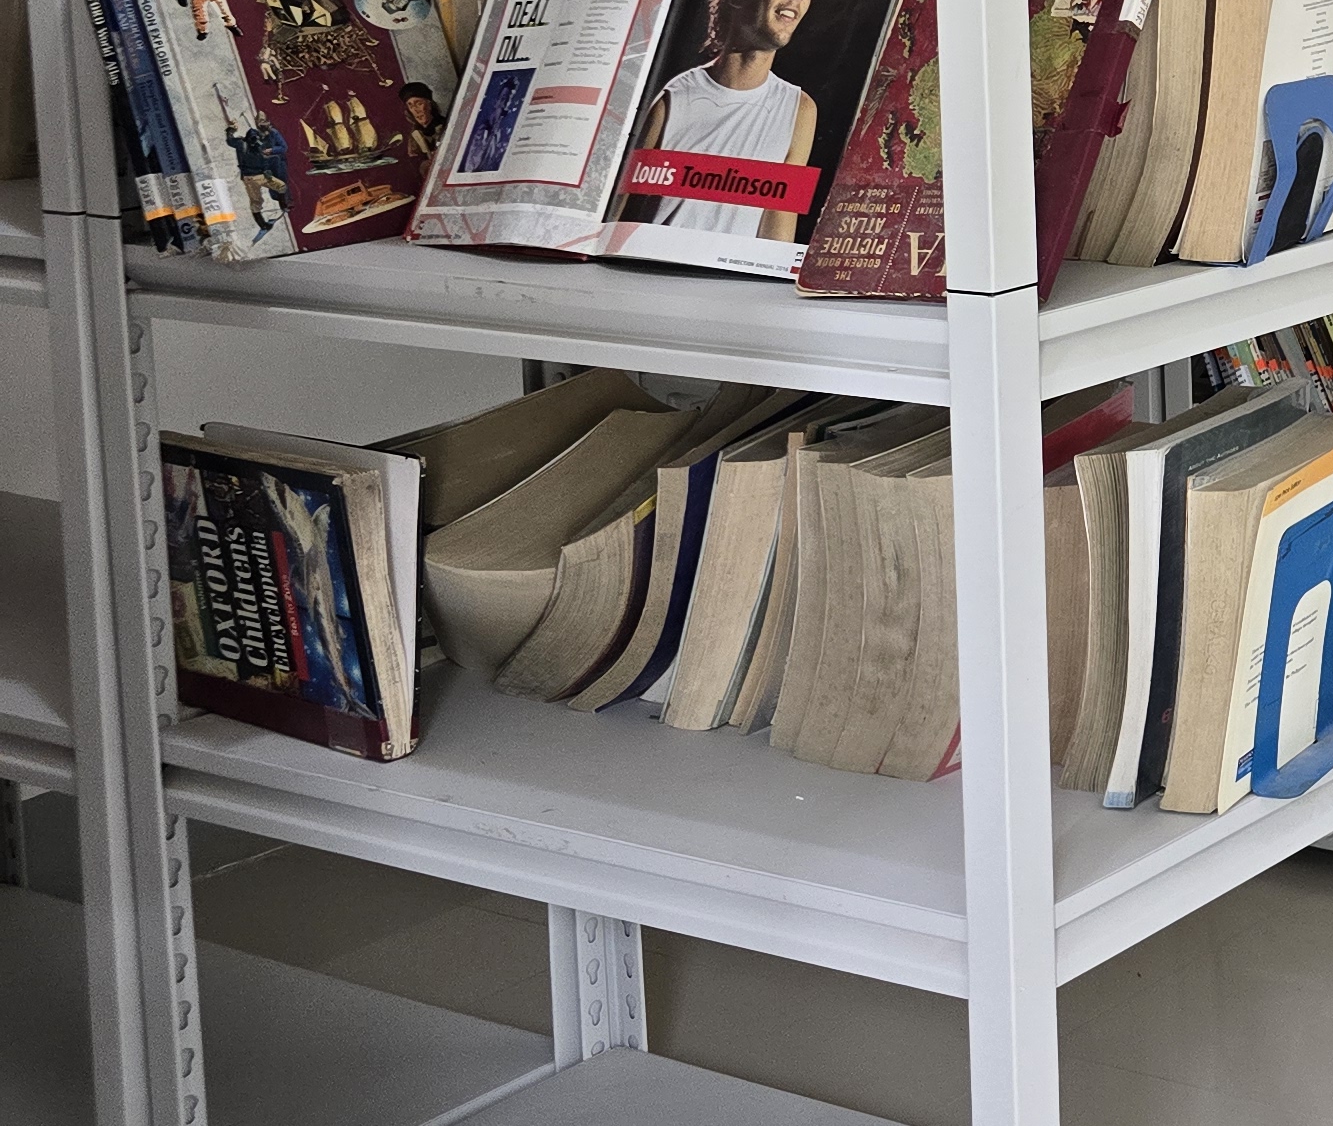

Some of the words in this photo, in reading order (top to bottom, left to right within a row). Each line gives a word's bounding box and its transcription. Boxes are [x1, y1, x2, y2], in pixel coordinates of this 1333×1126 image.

[508, 0, 549, 27] DEAL
[94, 26, 112, 58] World
[148, 26, 172, 77] EXPLORED
[631, 161, 677, 186] Louis
[680, 166, 788, 199] Tomlinson
[836, 203, 865, 212] WORLD
[888, 203, 900, 213] OF
[839, 217, 886, 233] ATLAS
[821, 237, 888, 255] PICTURE
[816, 257, 841, 268] BOOK
[850, 258, 881, 268] GOLDEN
[834, 271, 851, 280] THE
[197, 519, 241, 660] OXFORD
[225, 527, 268, 666] Children's
[251, 531, 290, 671] Encyclopedia
